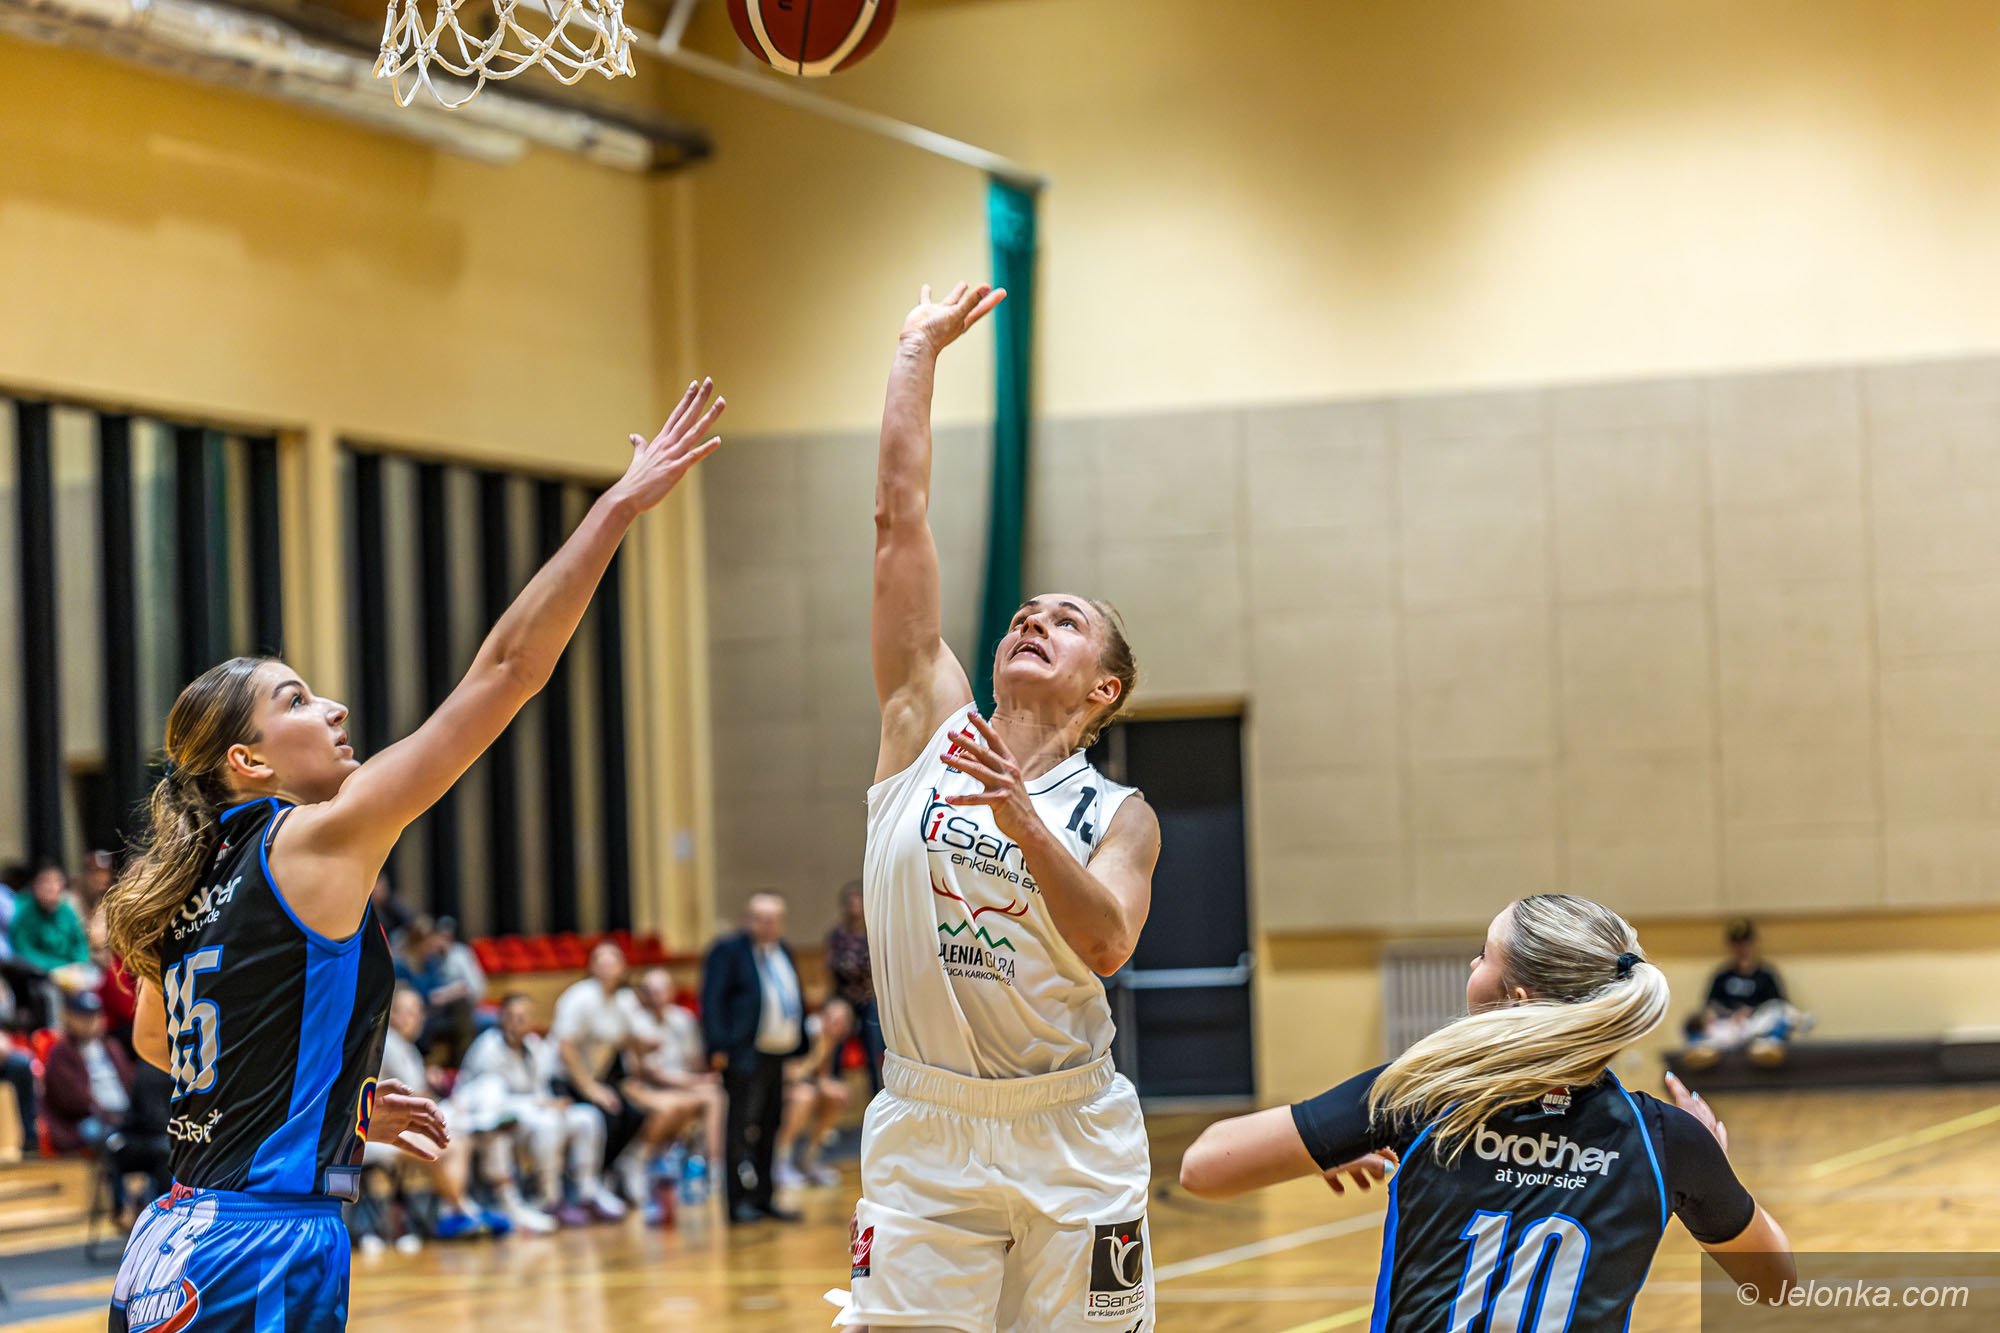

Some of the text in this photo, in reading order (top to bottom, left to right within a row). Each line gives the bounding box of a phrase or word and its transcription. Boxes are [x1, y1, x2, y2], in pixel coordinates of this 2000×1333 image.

[950, 853, 1019, 884] enklawa
[164, 945, 224, 1103] 15
[1543, 1093, 1572, 1106] MUKS
[1474, 1124, 1619, 1175] brother
[1495, 1168, 1587, 1190] at your side
[1446, 1209, 1591, 1333] 10
[1088, 1307, 1125, 1317] enklawa
